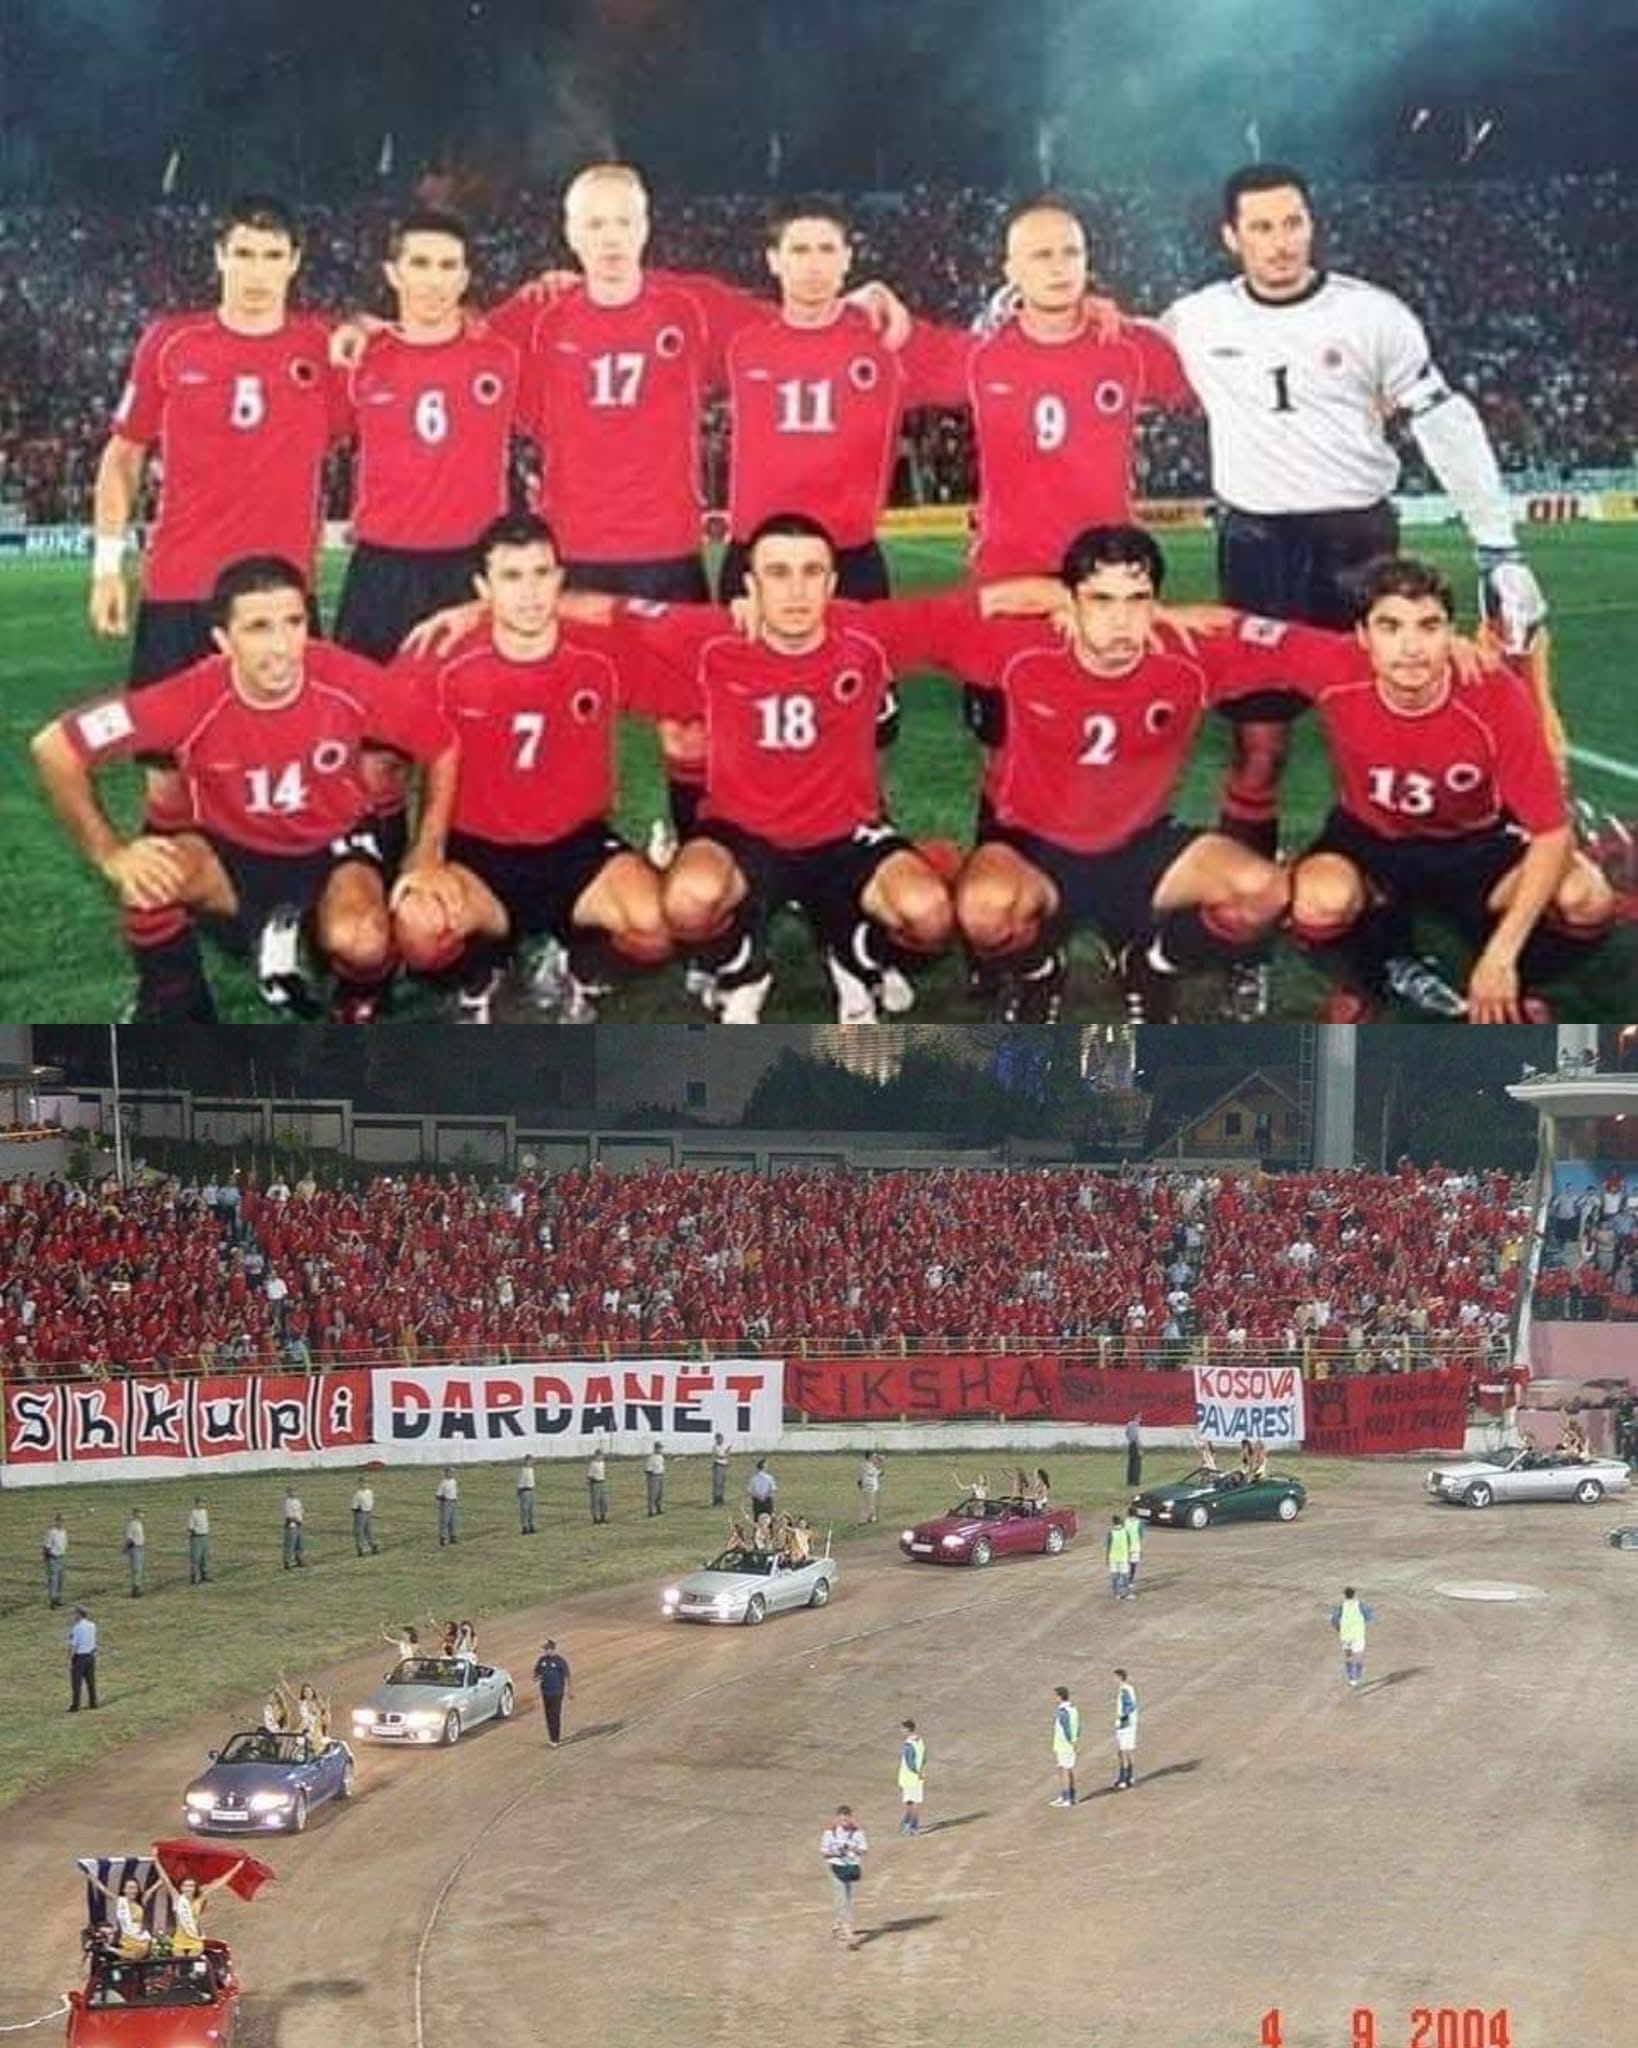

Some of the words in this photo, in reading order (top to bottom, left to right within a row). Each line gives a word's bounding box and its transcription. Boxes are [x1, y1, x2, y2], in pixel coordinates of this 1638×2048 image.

[231, 374, 265, 429] 5
[588, 352, 646, 407] 17
[775, 378, 836, 434] 11
[1264, 364, 1299, 413] 1
[414, 389, 449, 444] 6
[1034, 394, 1067, 450] 9
[511, 711, 545, 770] 7
[755, 694, 818, 750] 18
[1077, 714, 1119, 766] 2
[244, 760, 308, 815] 14
[1367, 765, 1435, 815] 13
[389, 1365, 764, 1440] DARDANËT
[1199, 1368, 1295, 1400] KOSOVA
[11, 1384, 352, 1451] Shkupi
